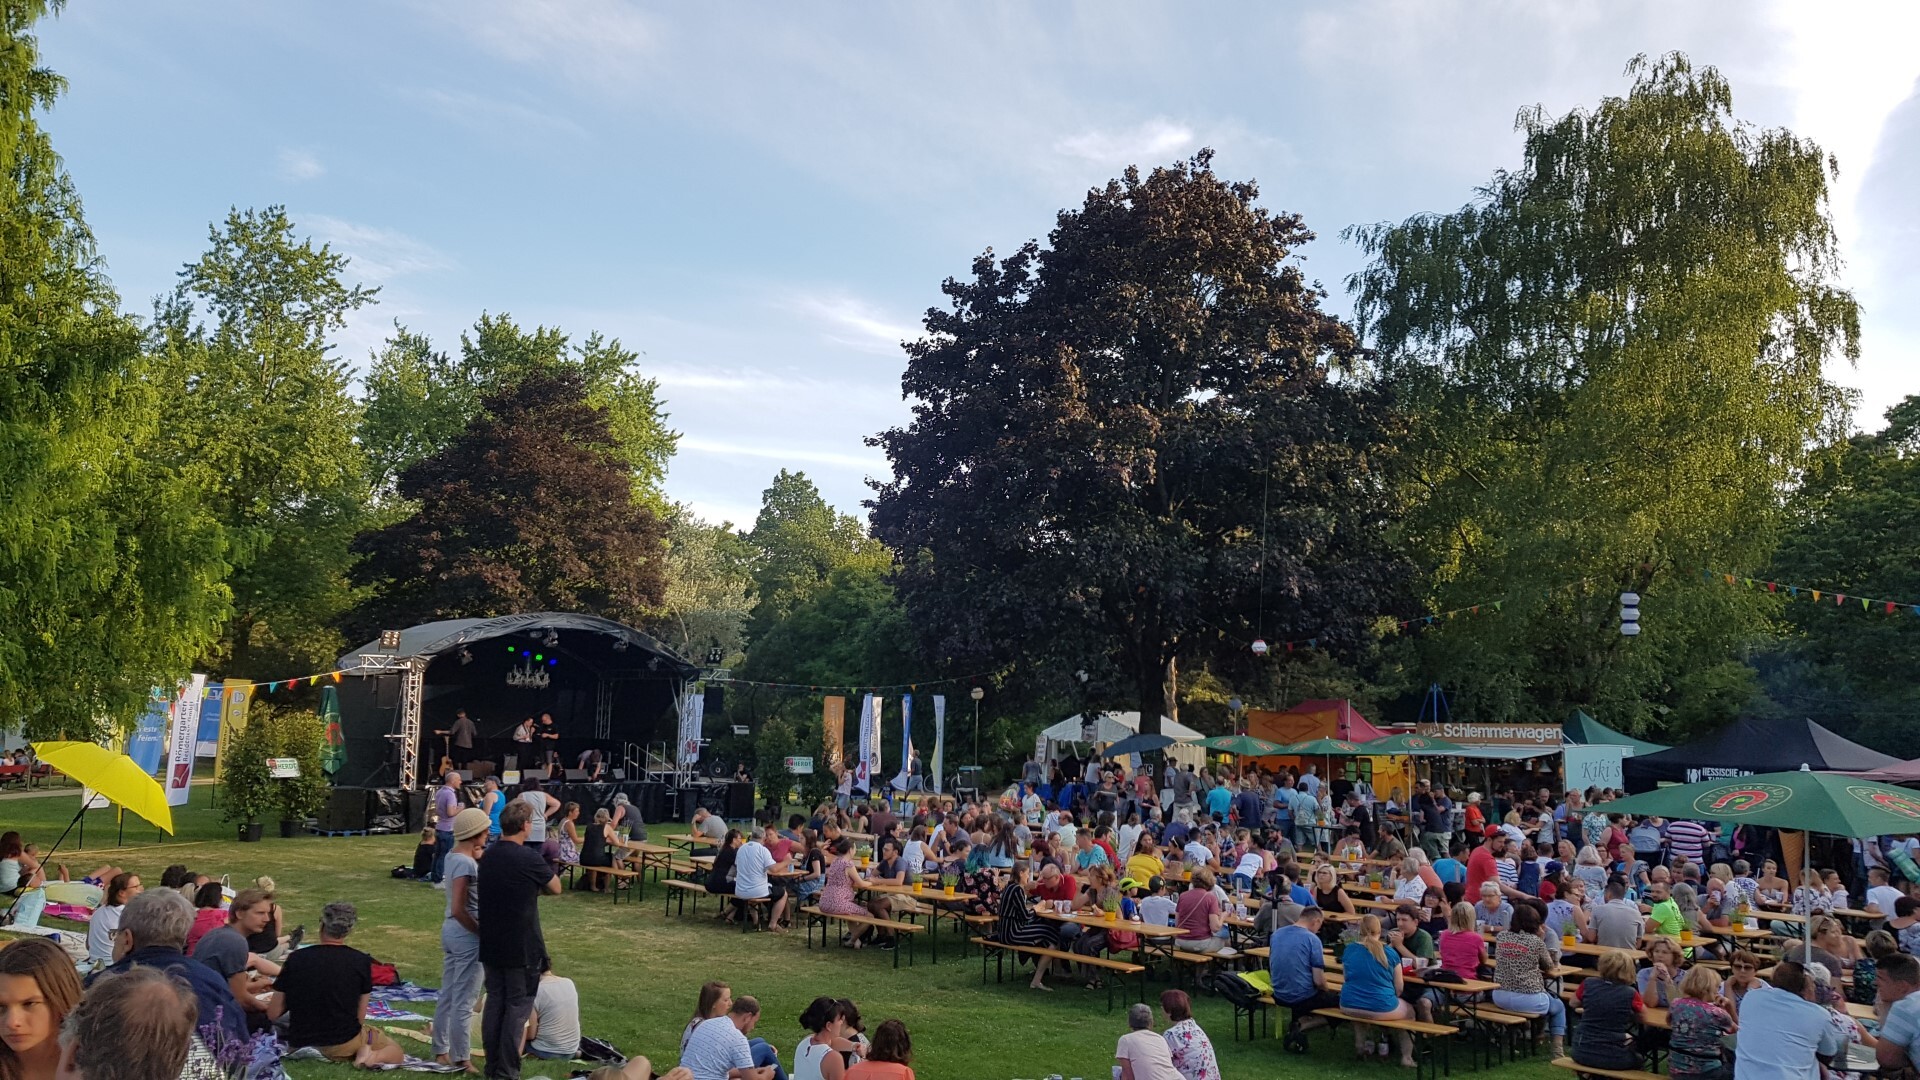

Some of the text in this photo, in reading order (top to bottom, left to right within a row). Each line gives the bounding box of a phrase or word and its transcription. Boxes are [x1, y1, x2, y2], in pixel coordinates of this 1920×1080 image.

[175, 700, 187, 762] Römergarten
[1443, 723, 1562, 743] Schlemmerwagen
[1702, 767, 1739, 777] HESSISCHE
